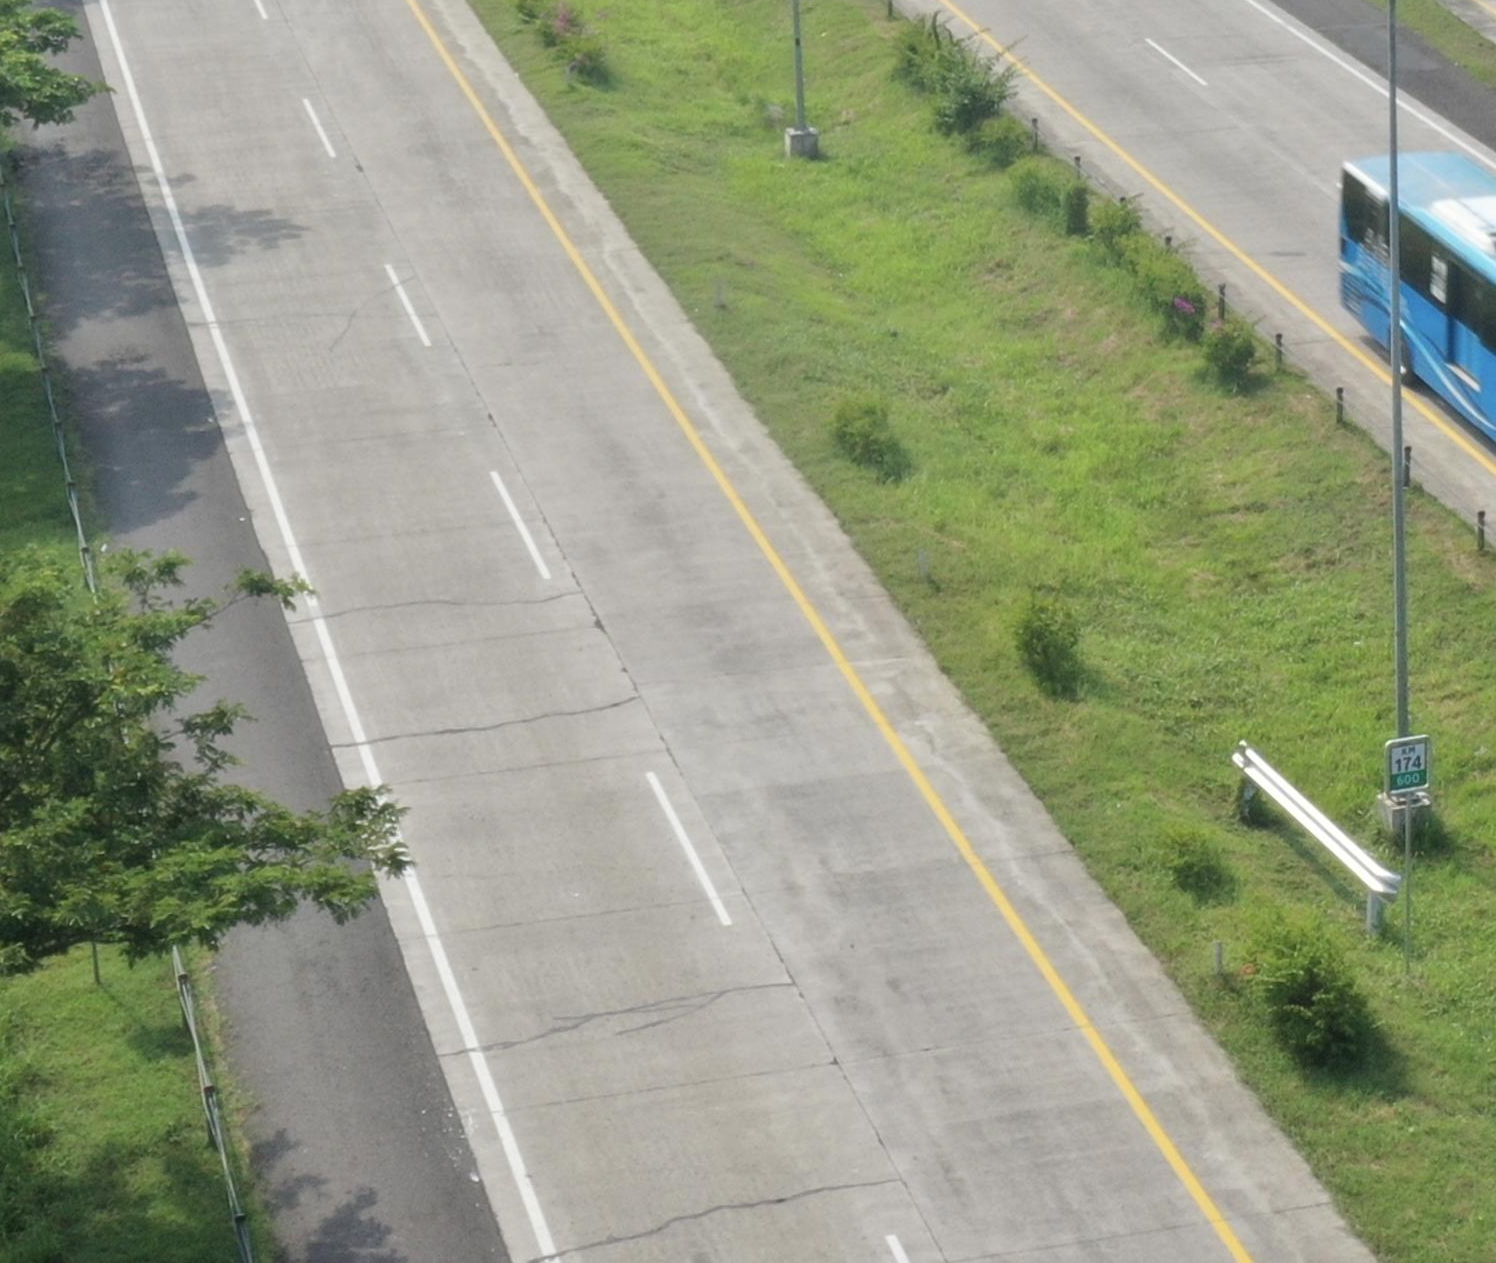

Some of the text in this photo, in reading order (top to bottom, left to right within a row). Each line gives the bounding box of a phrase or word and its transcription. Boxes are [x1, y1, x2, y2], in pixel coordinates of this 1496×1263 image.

[1401, 745, 1416, 755] KM
[1395, 755, 1422, 772] 174
[1397, 773, 1420, 786] 600
